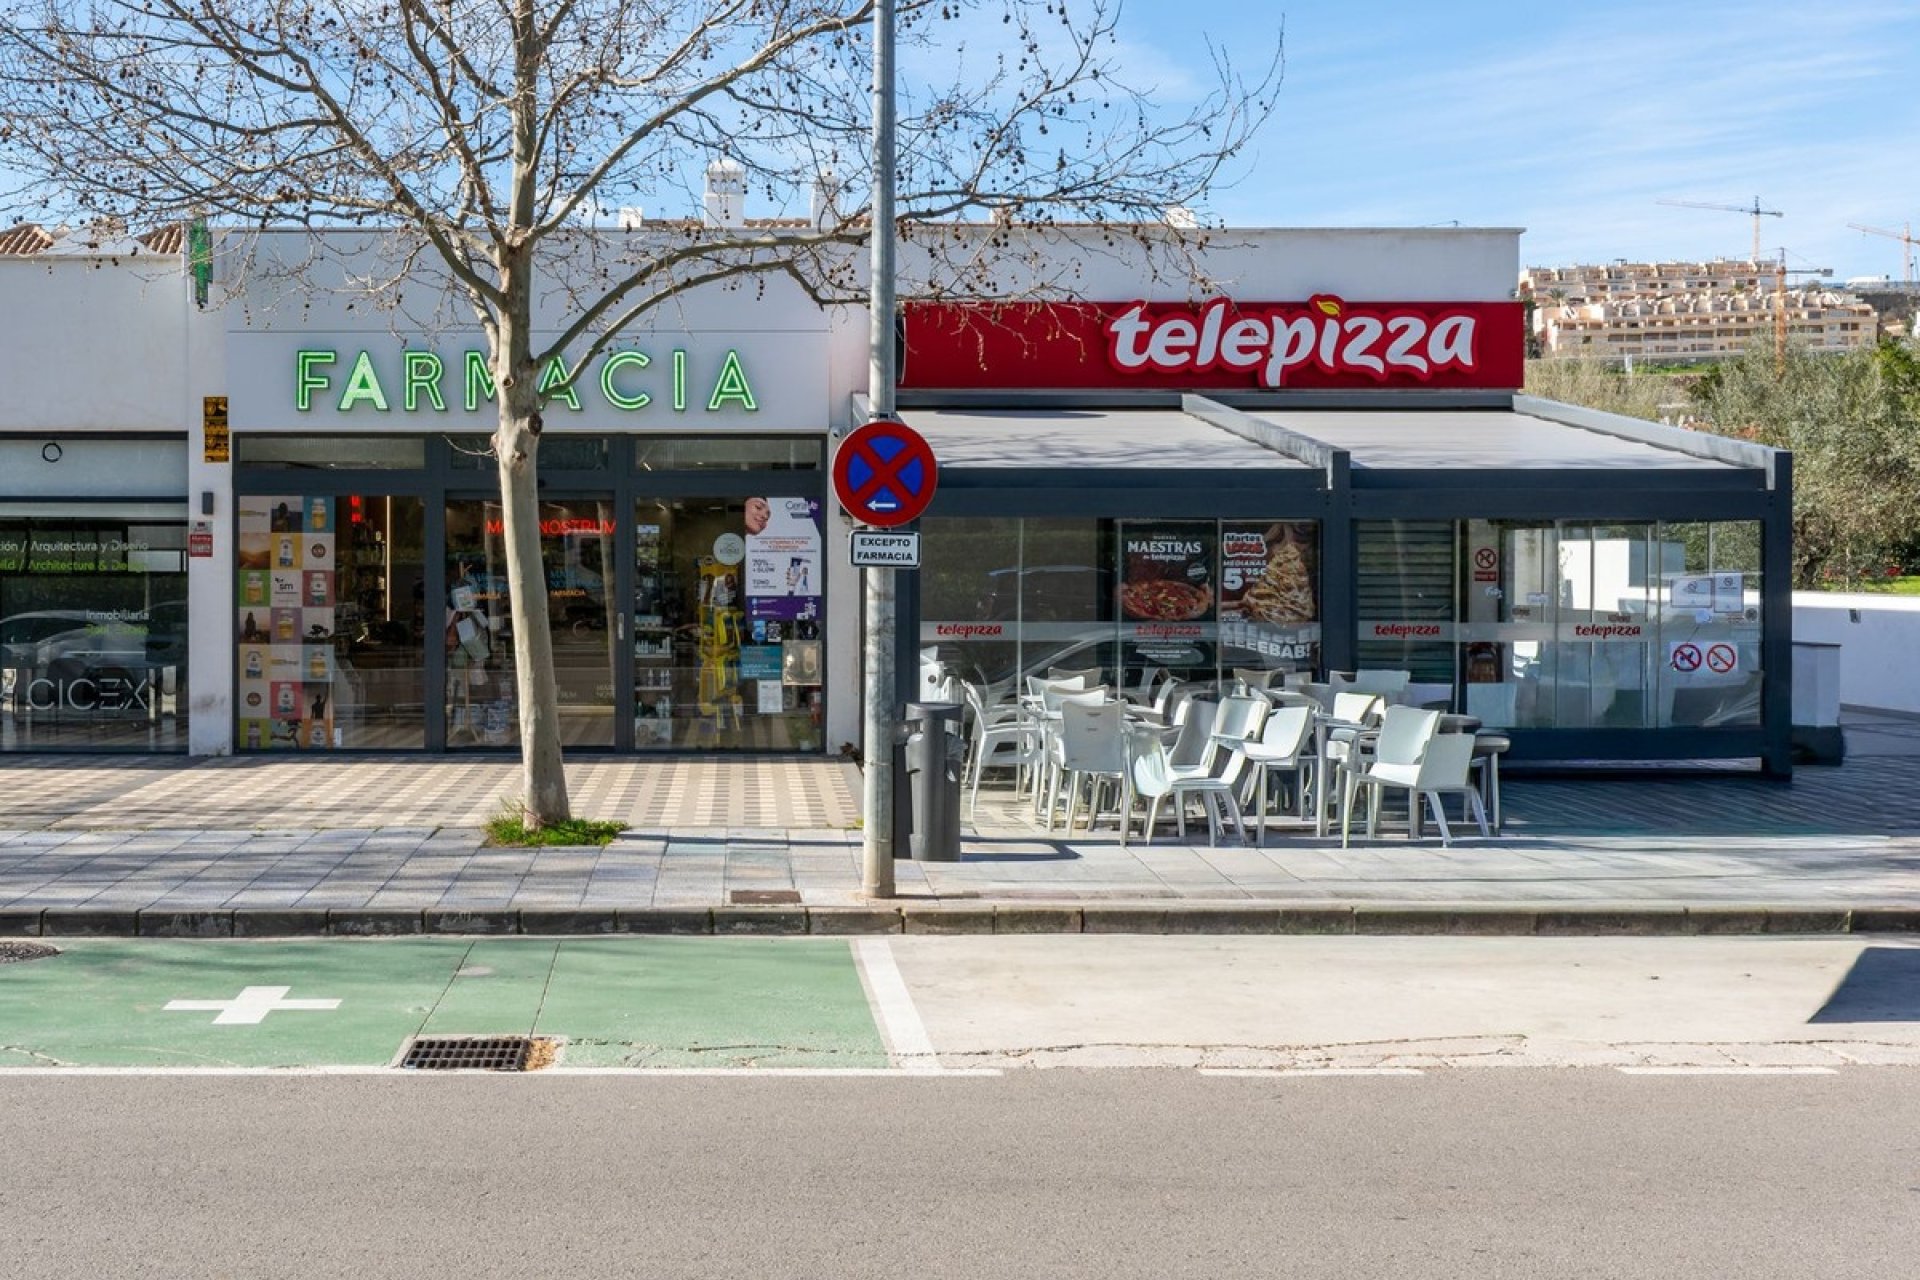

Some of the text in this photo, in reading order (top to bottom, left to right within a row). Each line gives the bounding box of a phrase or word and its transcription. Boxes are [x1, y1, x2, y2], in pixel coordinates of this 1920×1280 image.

[1110, 303, 1475, 387] telepizza
[296, 350, 759, 412] FARMACIA
[861, 538, 911, 547] EXCEPTO
[1225, 533, 1261, 542] Martes
[0, 541, 18, 551] ión
[31, 541, 97, 554] Arquitectura
[101, 543, 108, 554] y
[112, 539, 149, 551] Diseño
[1127, 541, 1202, 553] MAESTRAS
[857, 551, 913, 560] FARMACIA
[29, 559, 95, 571] Architecture
[86, 608, 150, 621] Inmobiliaria
[936, 624, 1002, 638] telepizza
[1136, 624, 1202, 638] telepizza
[1375, 624, 1441, 638] telepizza
[1575, 624, 1641, 639] telepizza
[28, 678, 148, 710] CICEX
